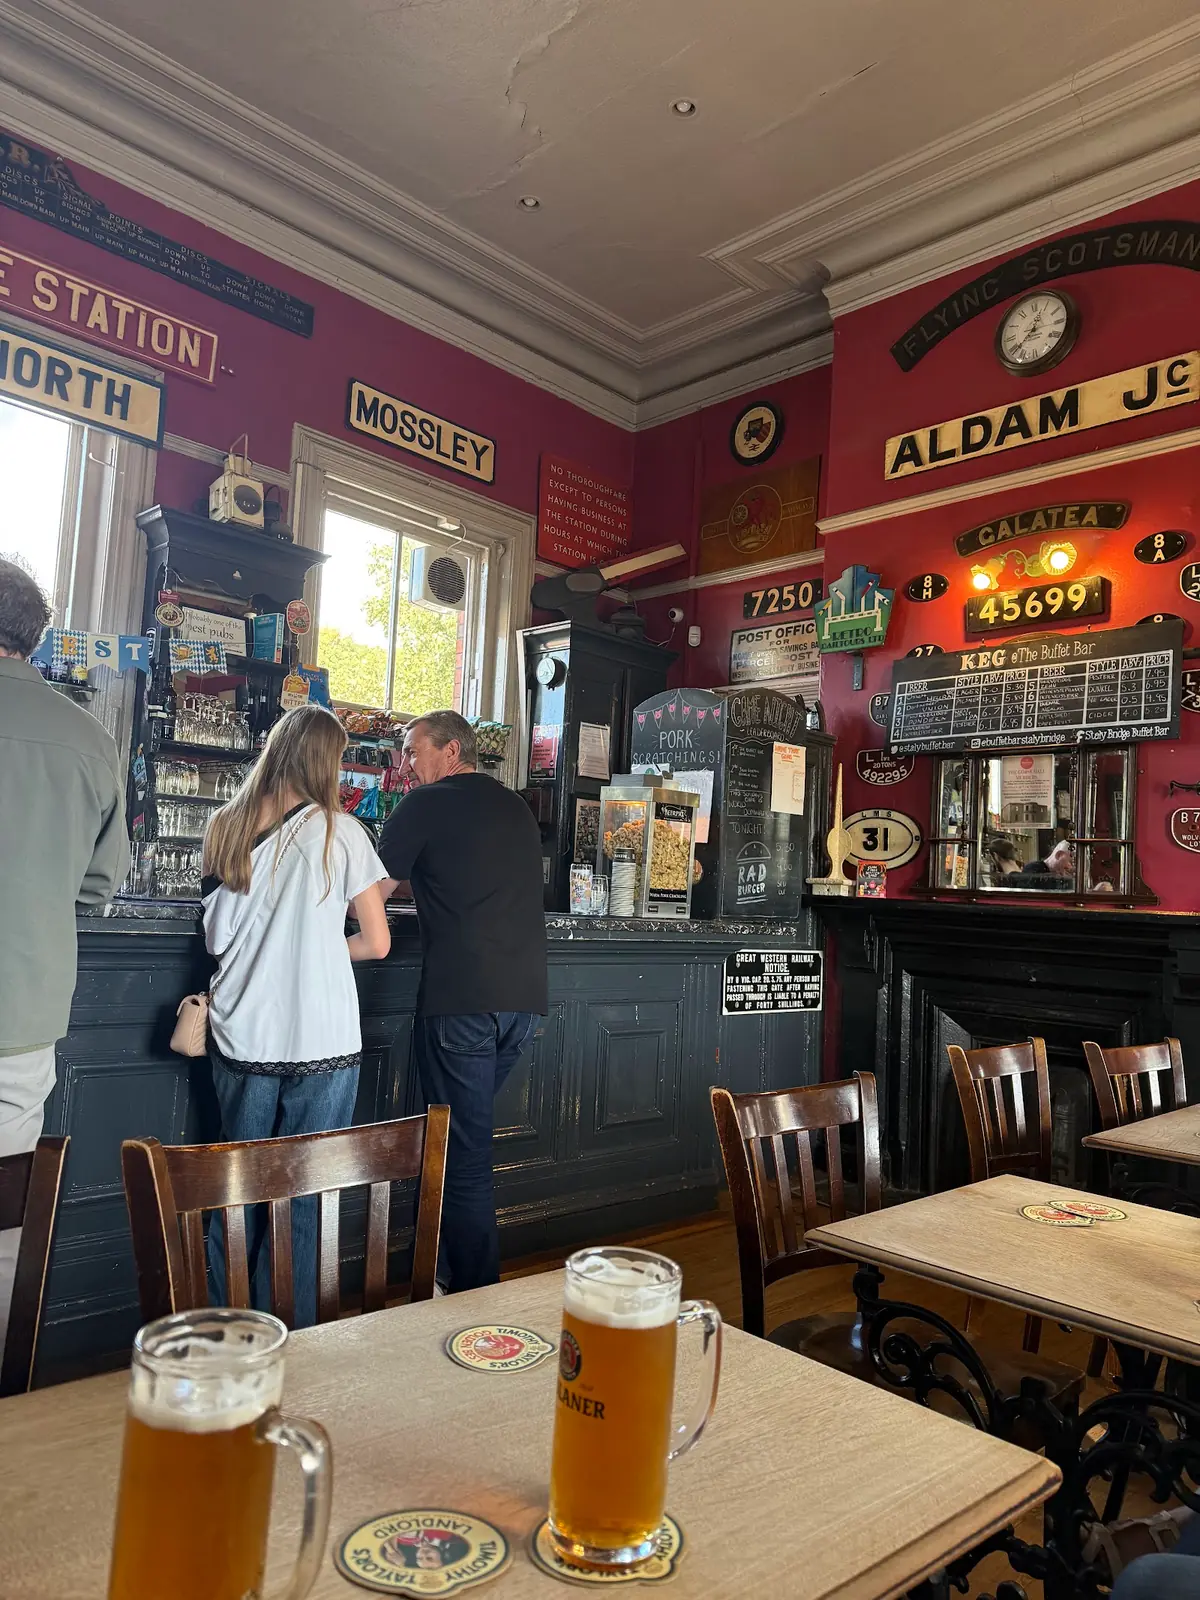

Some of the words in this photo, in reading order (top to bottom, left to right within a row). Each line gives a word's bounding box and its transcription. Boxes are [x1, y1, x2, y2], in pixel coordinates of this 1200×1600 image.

[902, 278, 1000, 360] FLYING
[1022, 230, 1200, 282] SCOTSMAN
[32, 270, 201, 368] STATION
[356, 389, 489, 471] MOSSLEY
[890, 387, 1080, 474] ALDAM
[550, 464, 563, 475] NO
[567, 471, 626, 501] THOROUGHFARE
[549, 479, 578, 496] EXCEPT
[582, 491, 592, 501] TO
[596, 498, 627, 517] PERSONS
[547, 494, 578, 512] HAVING
[581, 507, 615, 526] BUSINESS
[618, 521, 627, 530] AT
[546, 509, 561, 521] THE
[565, 516, 598, 534] STATION
[600, 529, 627, 546] DURING
[978, 505, 1098, 547] GALATEA
[543, 524, 571, 540] HOURS
[574, 535, 583, 544] AT
[586, 539, 612, 555] WHICH
[1154, 533, 1165, 548] 8
[553, 543, 587, 561] STATION
[1153, 549, 1165, 562] A
[924, 575, 932, 588] 8
[751, 582, 813, 617] 7250
[922, 588, 932, 600] H
[979, 583, 1087, 624] 45699
[210, 627, 234, 640] pubs
[738, 630, 772, 645] POST
[775, 622, 817, 639] OFFIC
[832, 626, 873, 642] RETRO
[868, 634, 884, 645] LTD
[780, 643, 807, 653] SAVINGS
[960, 649, 1006, 671] KEG
[1040, 642, 1070, 660] Buffet
[1074, 640, 1096, 656] Bar
[1043, 666, 1066, 677] BEER
[1090, 660, 1117, 673] STYLE
[1146, 654, 1170, 666] PRICE
[909, 682, 928, 693] BEER
[958, 675, 980, 687] STYLE
[1006, 670, 1026, 680] PRICE
[1028, 692, 1035, 700] 6
[1027, 704, 1034, 713] 7
[1026, 716, 1033, 727] 8
[1089, 712, 1114, 720] CIDER
[659, 729, 694, 749] PORK
[1085, 729, 1107, 741] Staly
[1107, 728, 1131, 742] Bridge
[1131, 726, 1153, 737] Buffet
[1154, 725, 1170, 736] Bar
[632, 750, 720, 765] SCRATCHINGS!
[862, 765, 907, 784] 492295
[862, 827, 889, 851] 31
[737, 863, 767, 882] RAD
[737, 883, 766, 896] BURGER
[736, 954, 756, 963] GREAT
[760, 954, 787, 963] WESTERN
[791, 954, 814, 963] RAILWAY
[727, 985, 754, 993] FASTENING
[757, 984, 768, 992] THIS
[727, 993, 744, 1001] PASSED
[746, 992, 766, 1000] THROUGH
[767, 992, 773, 1000] IS
[745, 1002, 752, 1010] OF
[756, 1001, 773, 1009] FORTY
[460, 1330, 492, 1349] GOLDEN
[496, 1328, 541, 1346] TIMOTHY
[462, 1349, 486, 1363] BEST
[489, 1351, 540, 1369] TAYLOR'S
[374, 1518, 473, 1539] LANDLORD
[353, 1548, 416, 1585] TAYLOR'S
[446, 1541, 497, 1582] TIMOTHY
